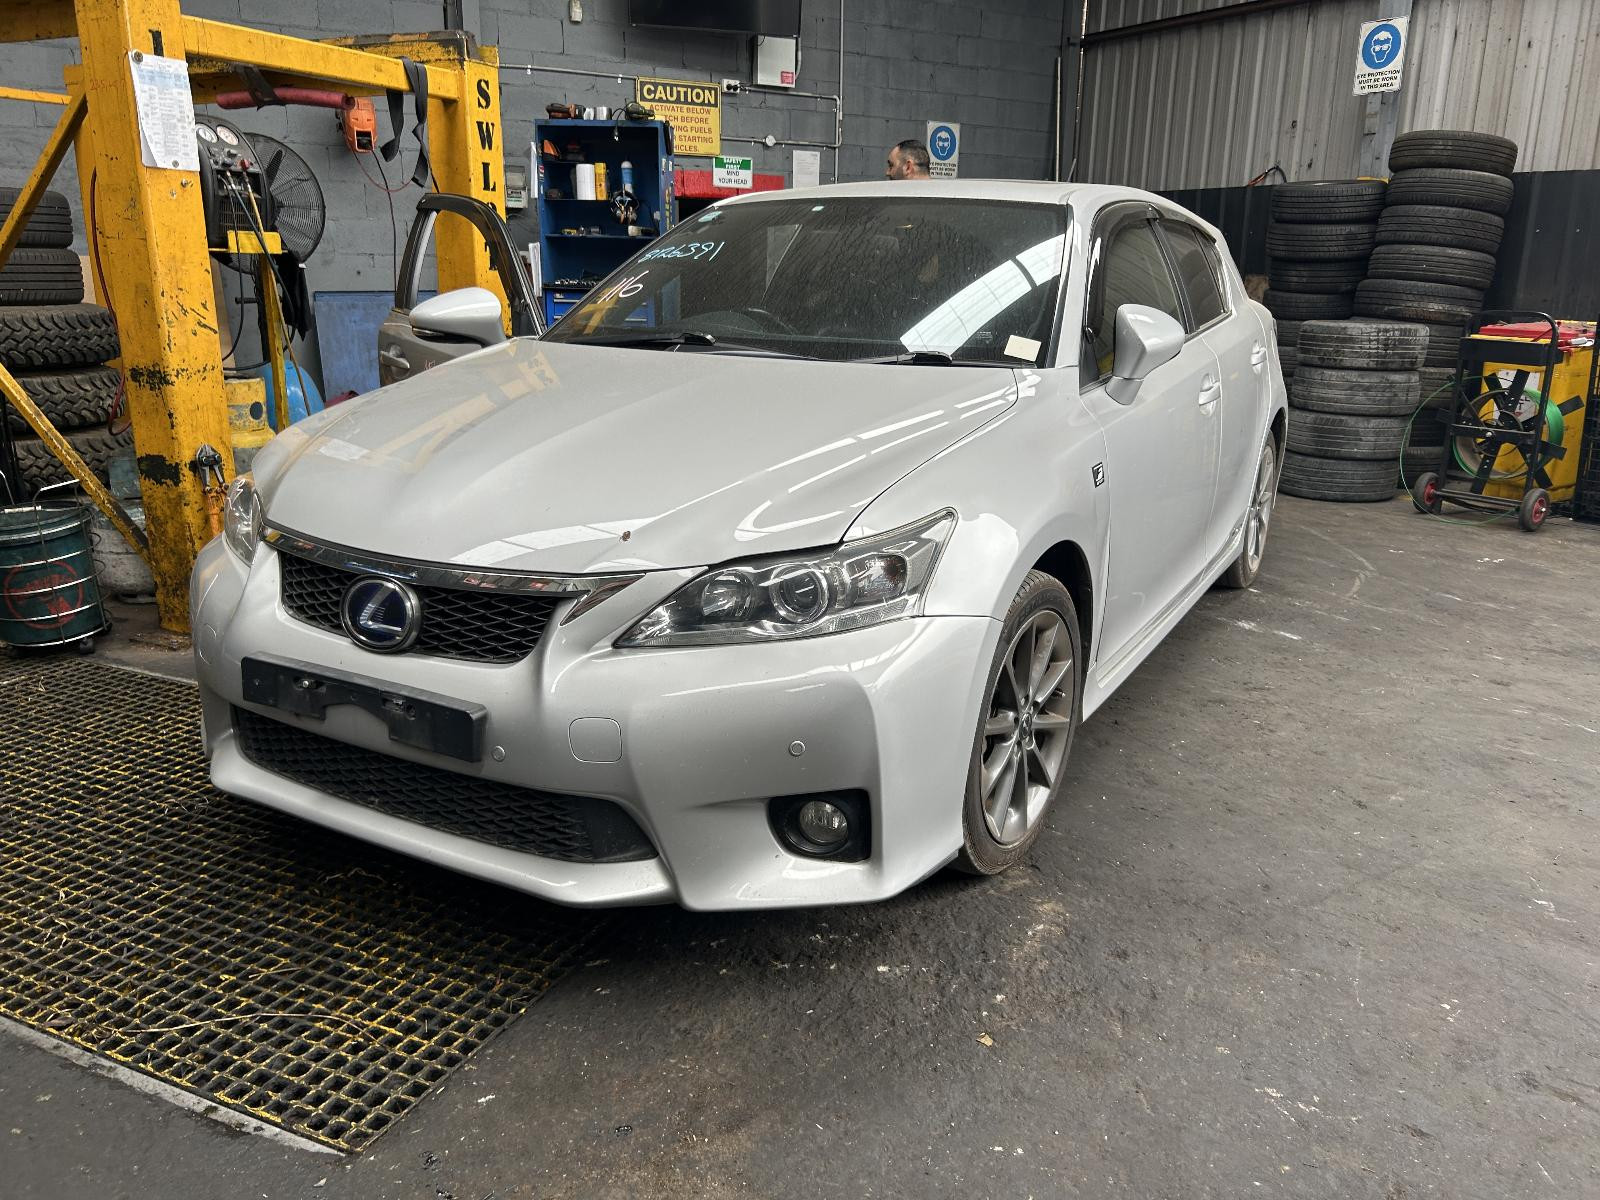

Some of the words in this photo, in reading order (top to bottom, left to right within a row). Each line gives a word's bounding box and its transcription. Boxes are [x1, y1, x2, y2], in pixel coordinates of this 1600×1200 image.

[1368, 69, 1400, 77] PROTECTION
[643, 84, 715, 104] CAUTION
[649, 104, 684, 113] ACTIVATE
[686, 106, 711, 115] BELOW
[680, 116, 709, 124] BEFORE
[690, 126, 713, 134] FUELS
[678, 134, 714, 143] STARTING
